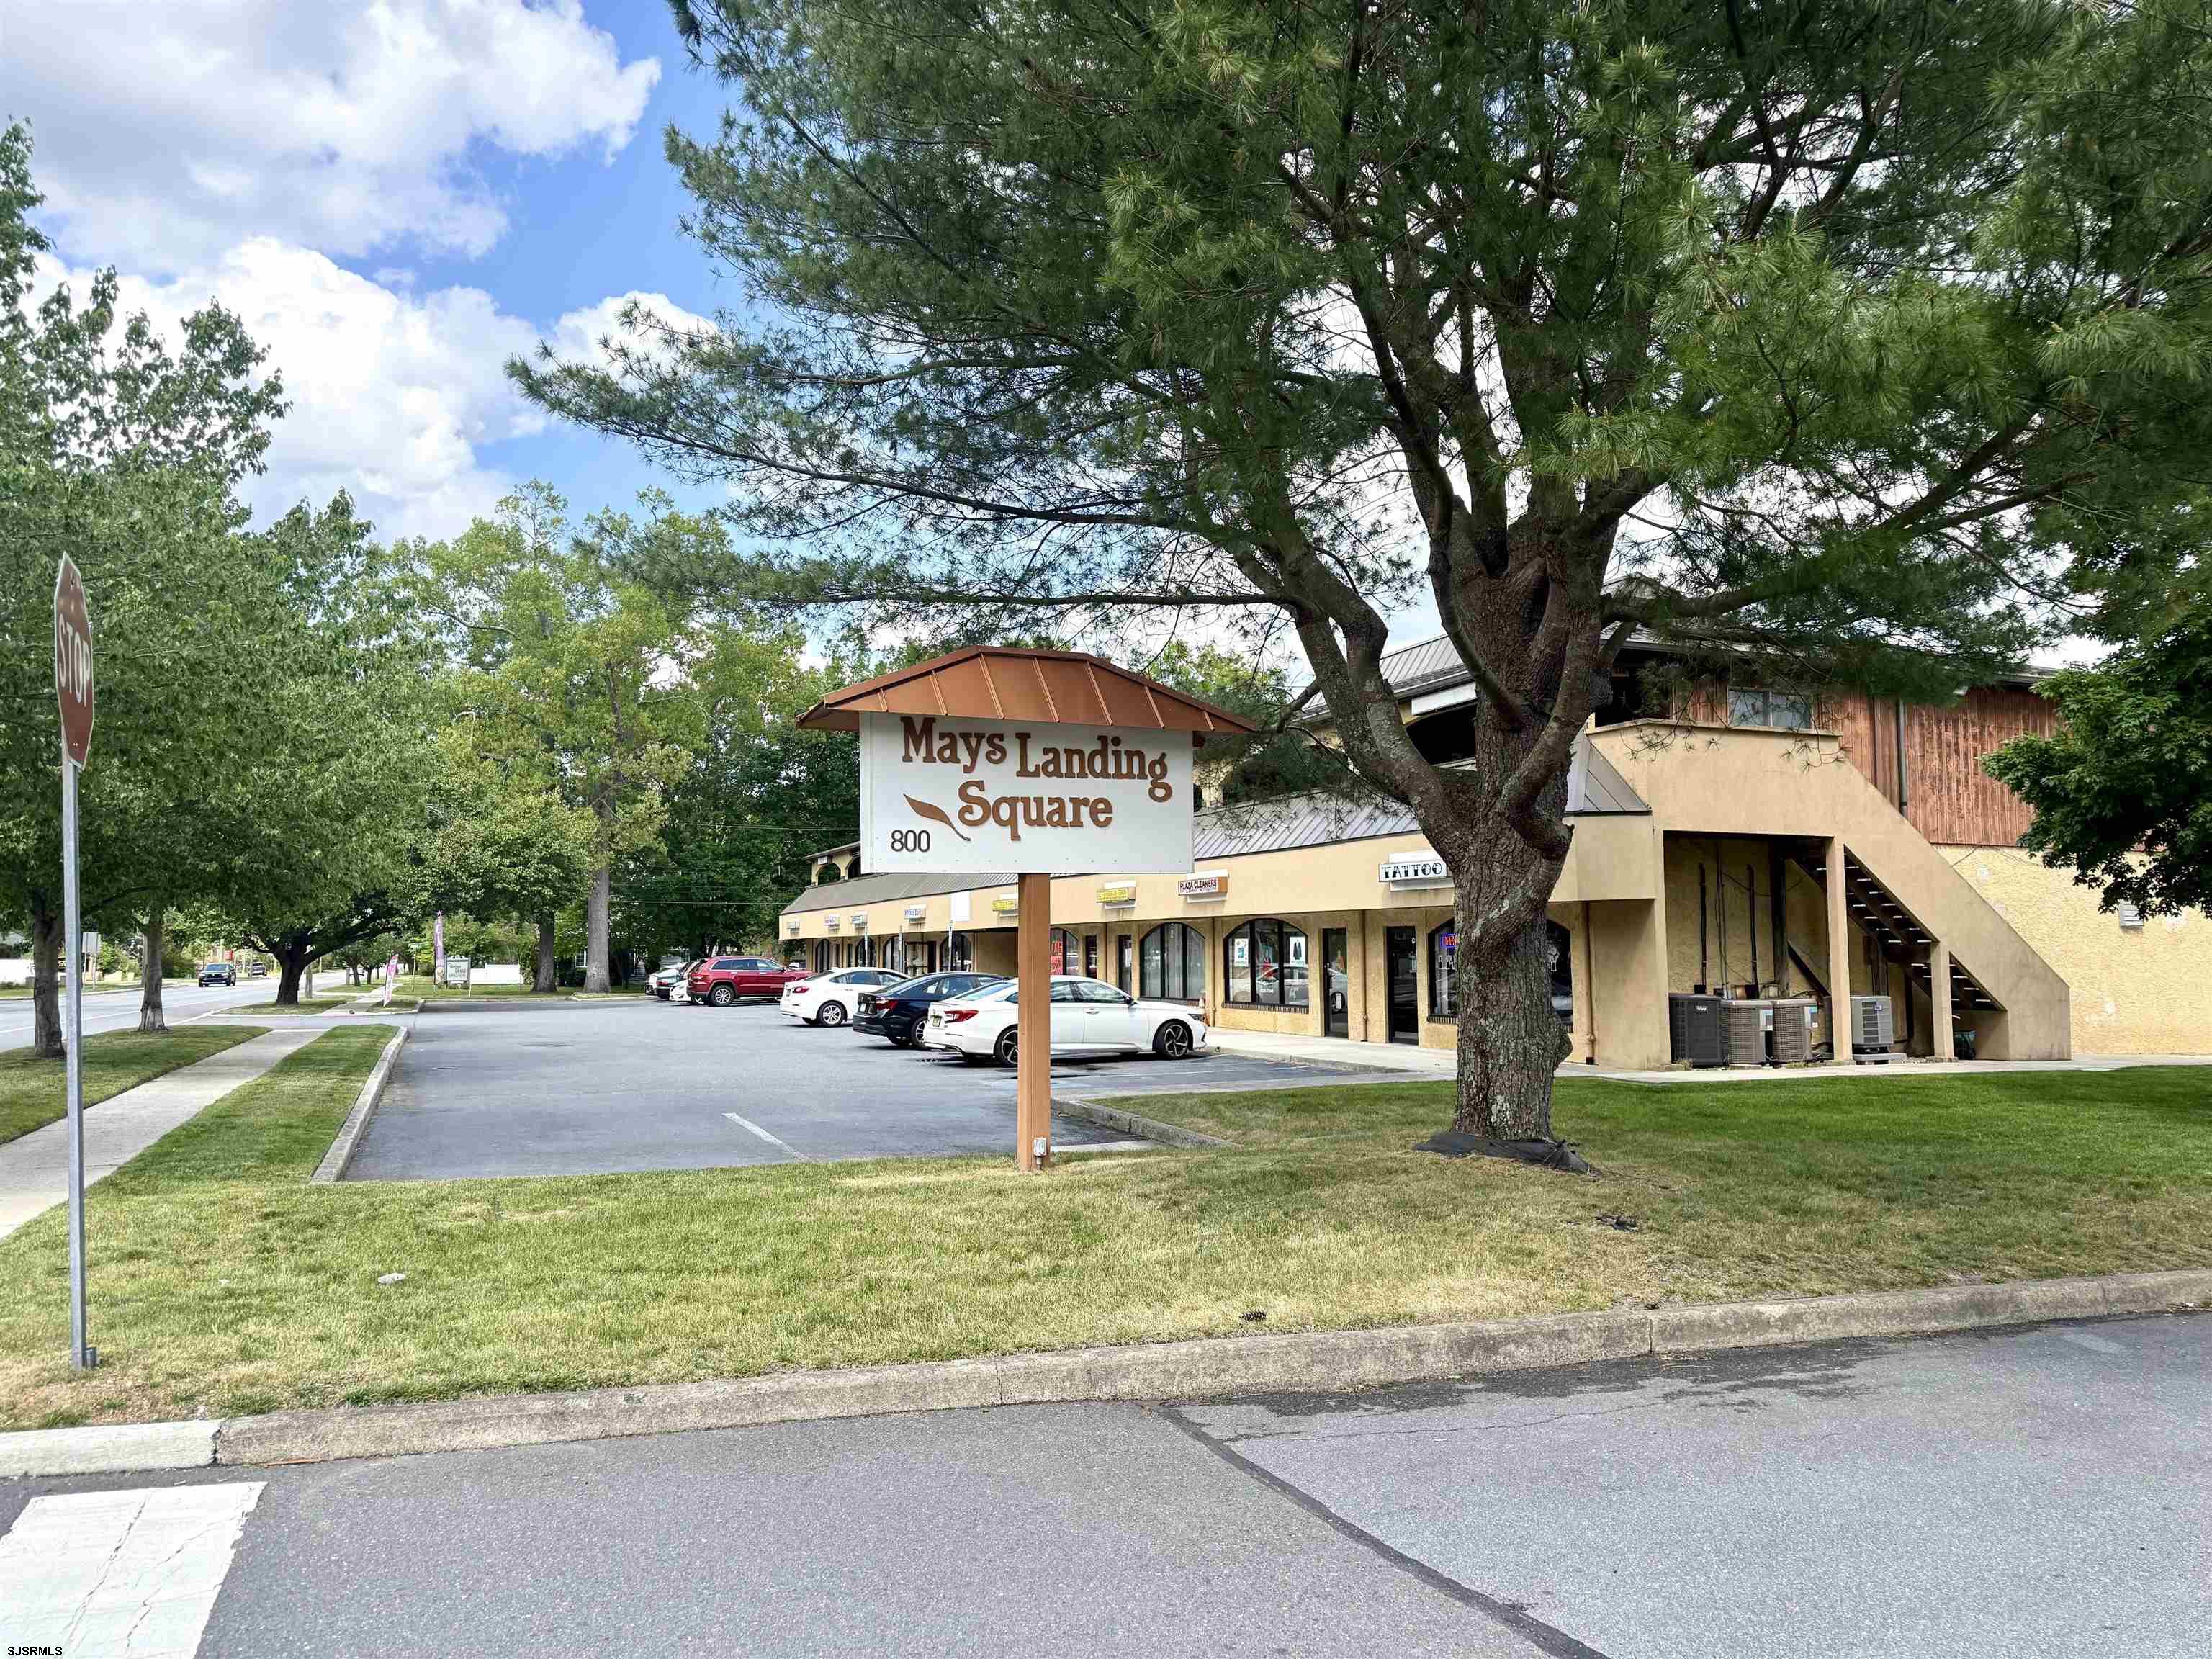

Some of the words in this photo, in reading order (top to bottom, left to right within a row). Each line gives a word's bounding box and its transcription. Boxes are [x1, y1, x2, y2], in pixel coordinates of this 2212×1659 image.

[59, 613, 90, 707] STOP
[900, 716, 1007, 773] Mays
[1015, 732, 1173, 803] Landing
[958, 780, 1113, 841] Square
[890, 829, 930, 853] 800
[1194, 878, 1217, 889] CLEANERS
[1382, 862, 1443, 878] TATTOO
